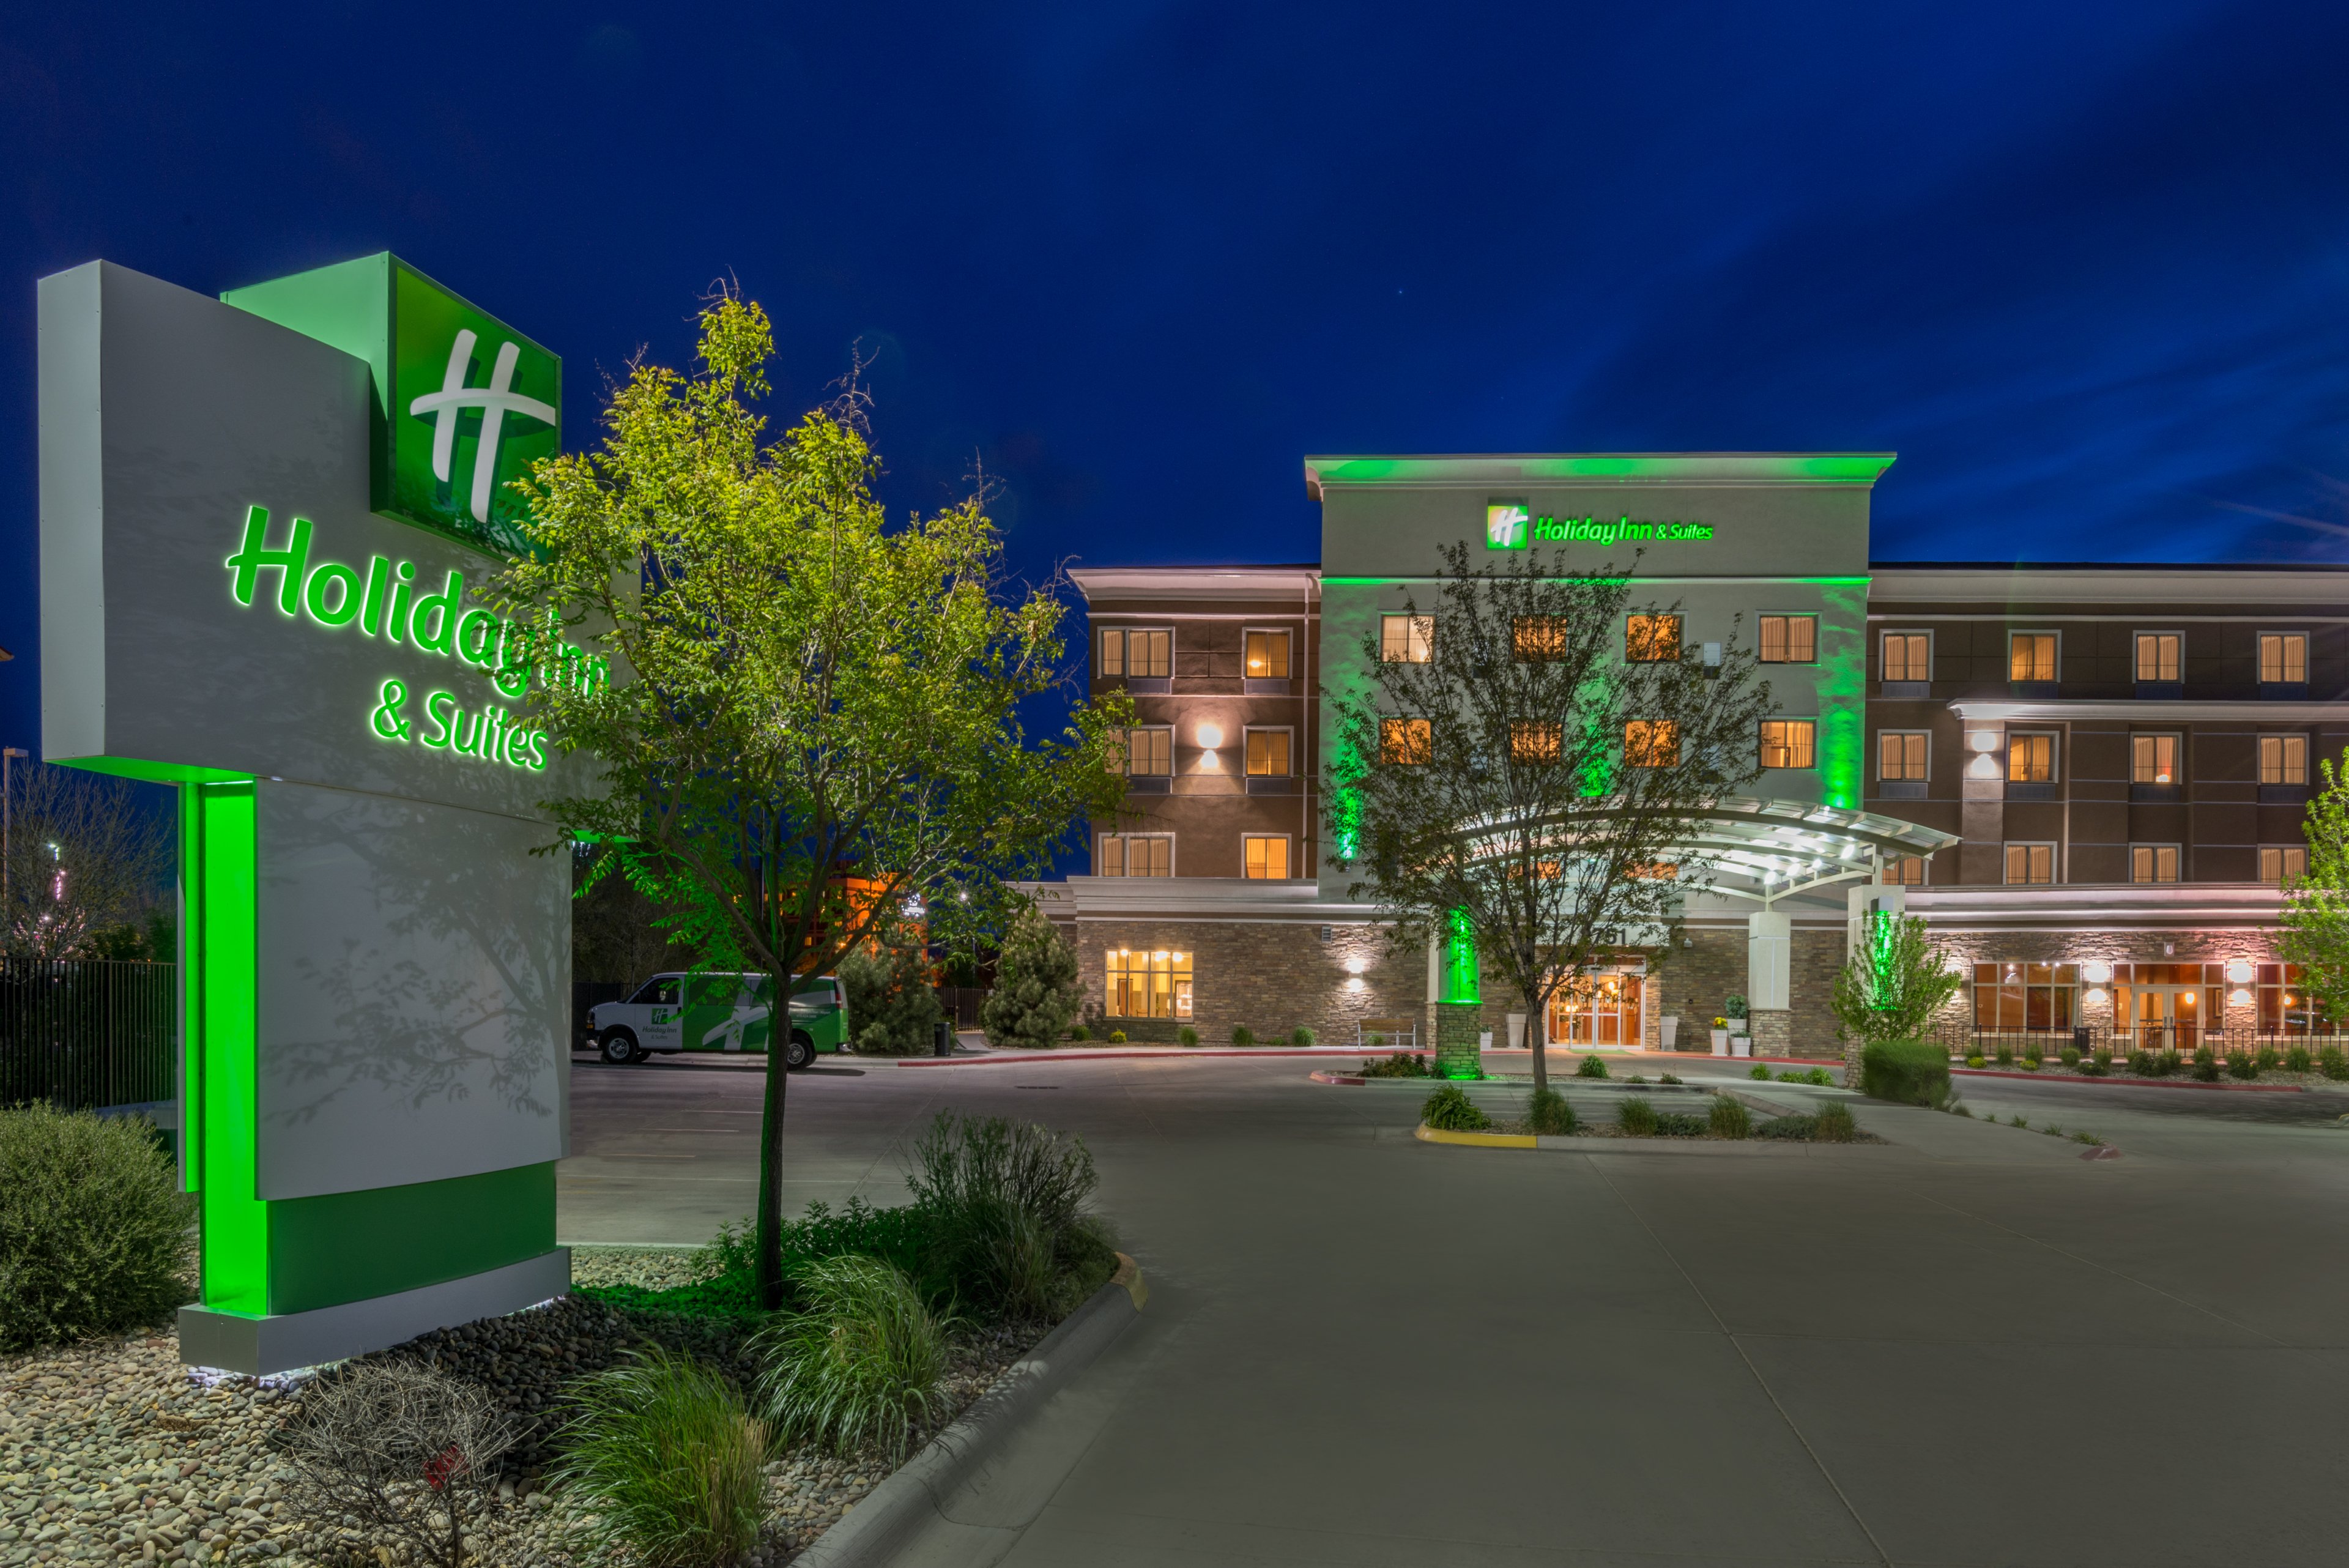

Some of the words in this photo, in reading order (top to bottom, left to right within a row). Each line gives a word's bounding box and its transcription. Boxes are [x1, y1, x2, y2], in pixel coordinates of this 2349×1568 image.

[1534, 518, 1617, 546] Holiday
[1619, 516, 1652, 540] Inn
[1656, 524, 1667, 540] &
[1669, 524, 1713, 540] Suites
[225, 505, 536, 698] Holiday
[371, 678, 411, 742] &
[421, 691, 548, 770] Suites
